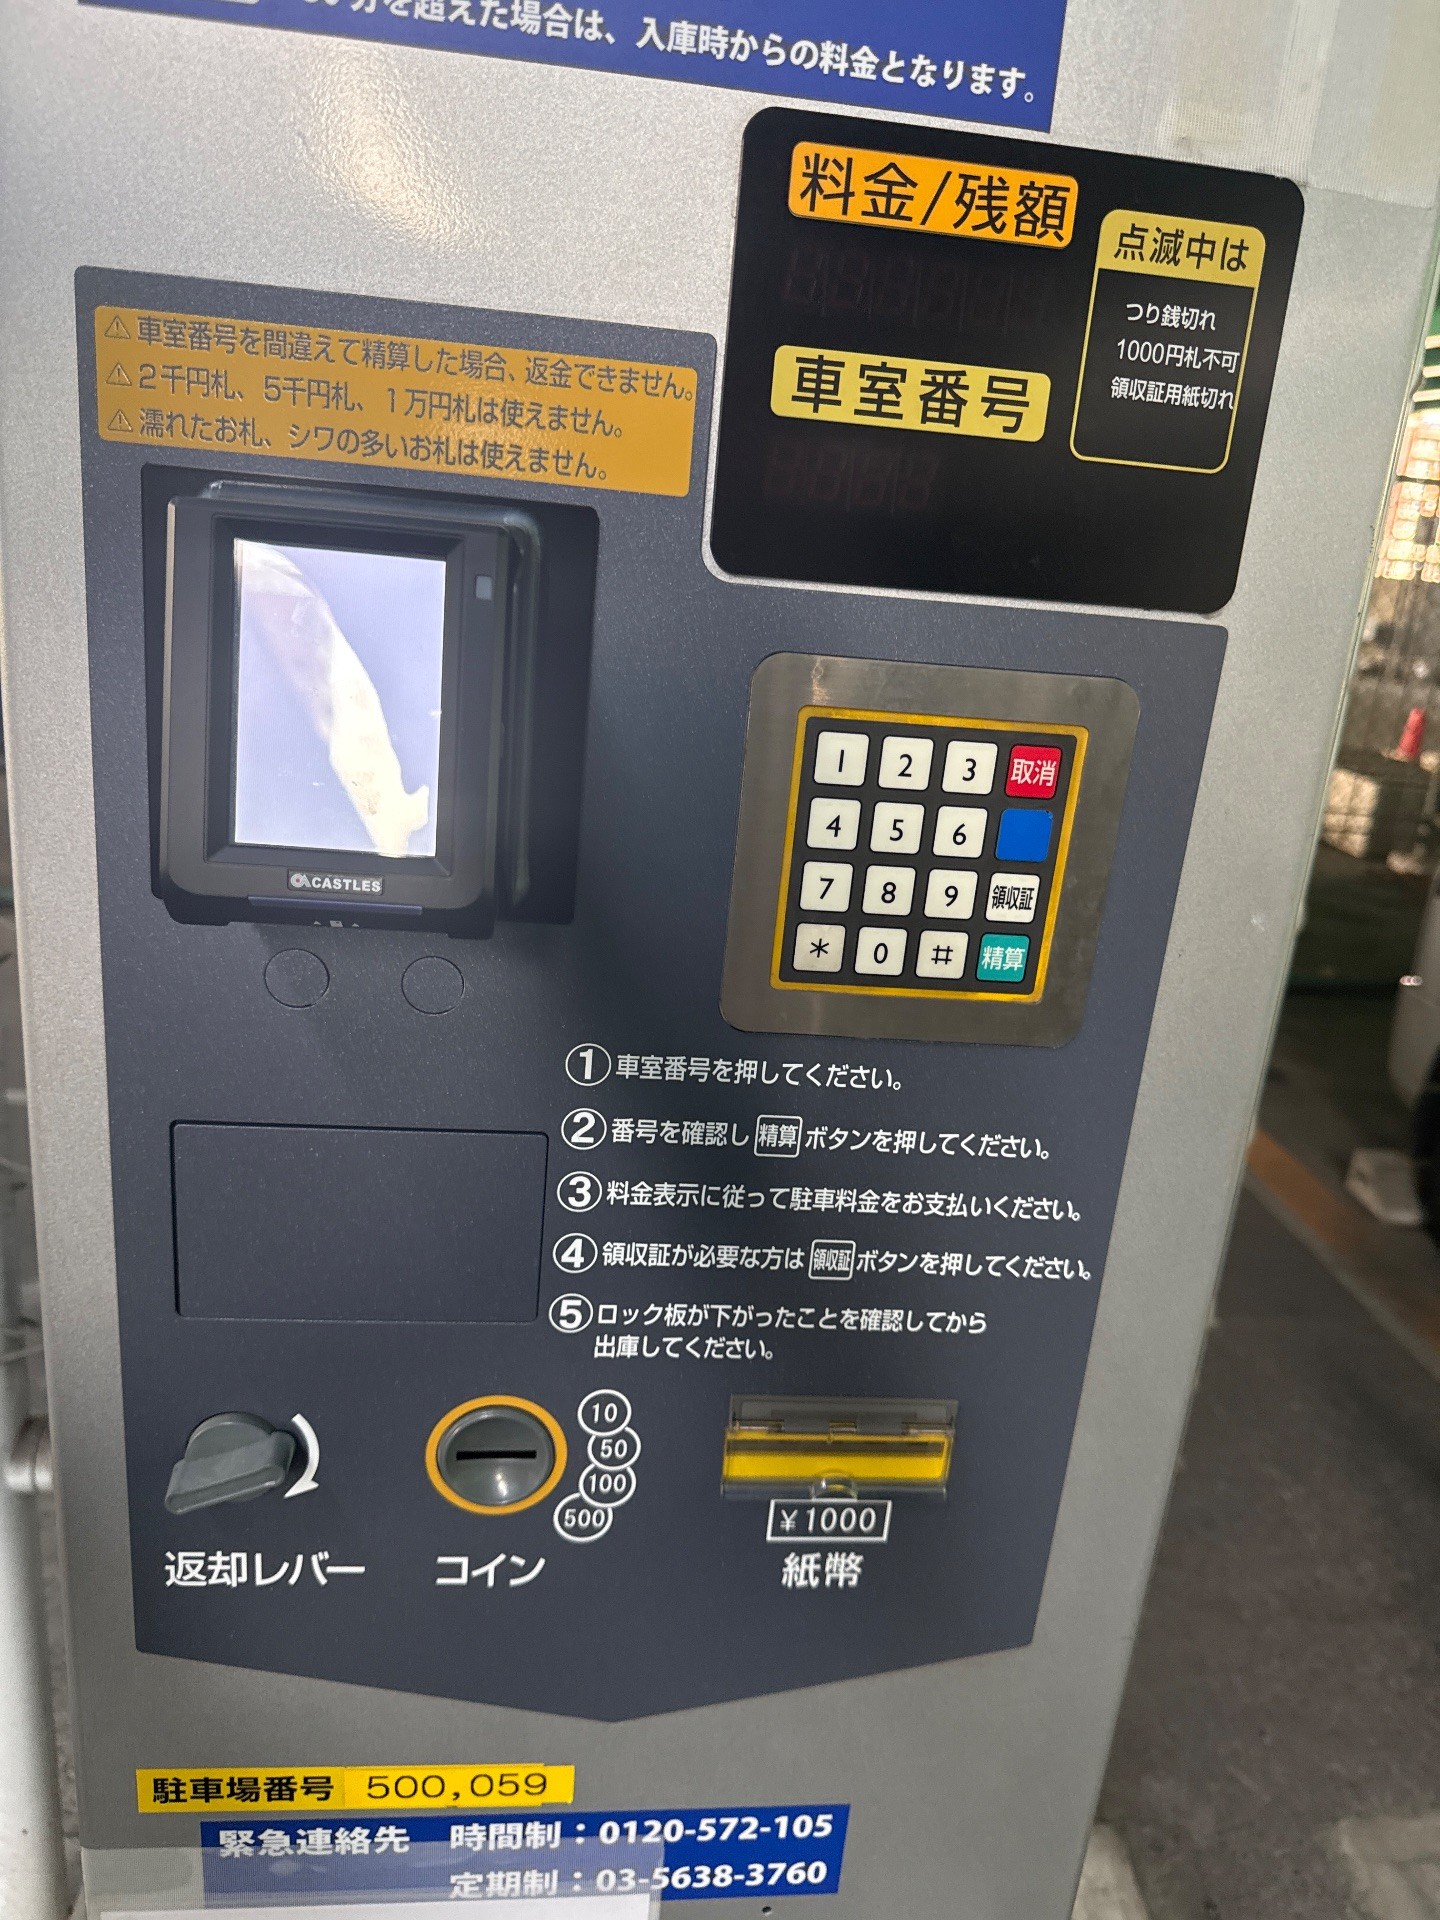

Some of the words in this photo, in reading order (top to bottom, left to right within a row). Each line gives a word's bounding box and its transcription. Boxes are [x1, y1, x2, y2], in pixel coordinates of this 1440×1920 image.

[799, 152, 1071, 244] 料金/残額
[1114, 224, 1249, 273] 点滅中は
[1126, 303, 1216, 331] つり銭切れ
[138, 316, 693, 402] 車室番号を間違えて精算した場合、返金できません。
[1117, 338, 1240, 374] 1000円札不可
[792, 355, 1031, 433] 車室番号
[1110, 376, 1234, 410] 領収証用紙切れ
[139, 408, 607, 481] 濡れたお札、シワの多いお札は使えません。
[837, 749, 845, 773] 1
[899, 754, 913, 778] 2
[962, 758, 976, 782] 3
[1012, 759, 1056, 785] 取消
[826, 815, 841, 838] 4
[890, 819, 904, 842] 5
[952, 823, 966, 845] 6
[312, 877, 381, 893] CASTLES
[819, 878, 833, 900] 7
[881, 882, 896, 904] 8
[944, 885, 958, 908] 9
[991, 886, 1035, 911] 領収証
[874, 943, 888, 965] 0
[982, 946, 1025, 971] 精算
[594, 1336, 774, 1361] 出庫してください。
[592, 1403, 618, 1424] 10
[600, 1438, 629, 1460] 50
[587, 1472, 625, 1495] 100
[563, 1506, 606, 1530] 500
[164, 1551, 366, 1588] 返却レバー
[437, 1555, 546, 1588] コイン
[783, 1553, 863, 1588] 紙幣
[153, 1775, 334, 1804] 駐車場番号
[367, 1773, 549, 1806] 500,059
[218, 1825, 410, 1858] 緊急連絡先
